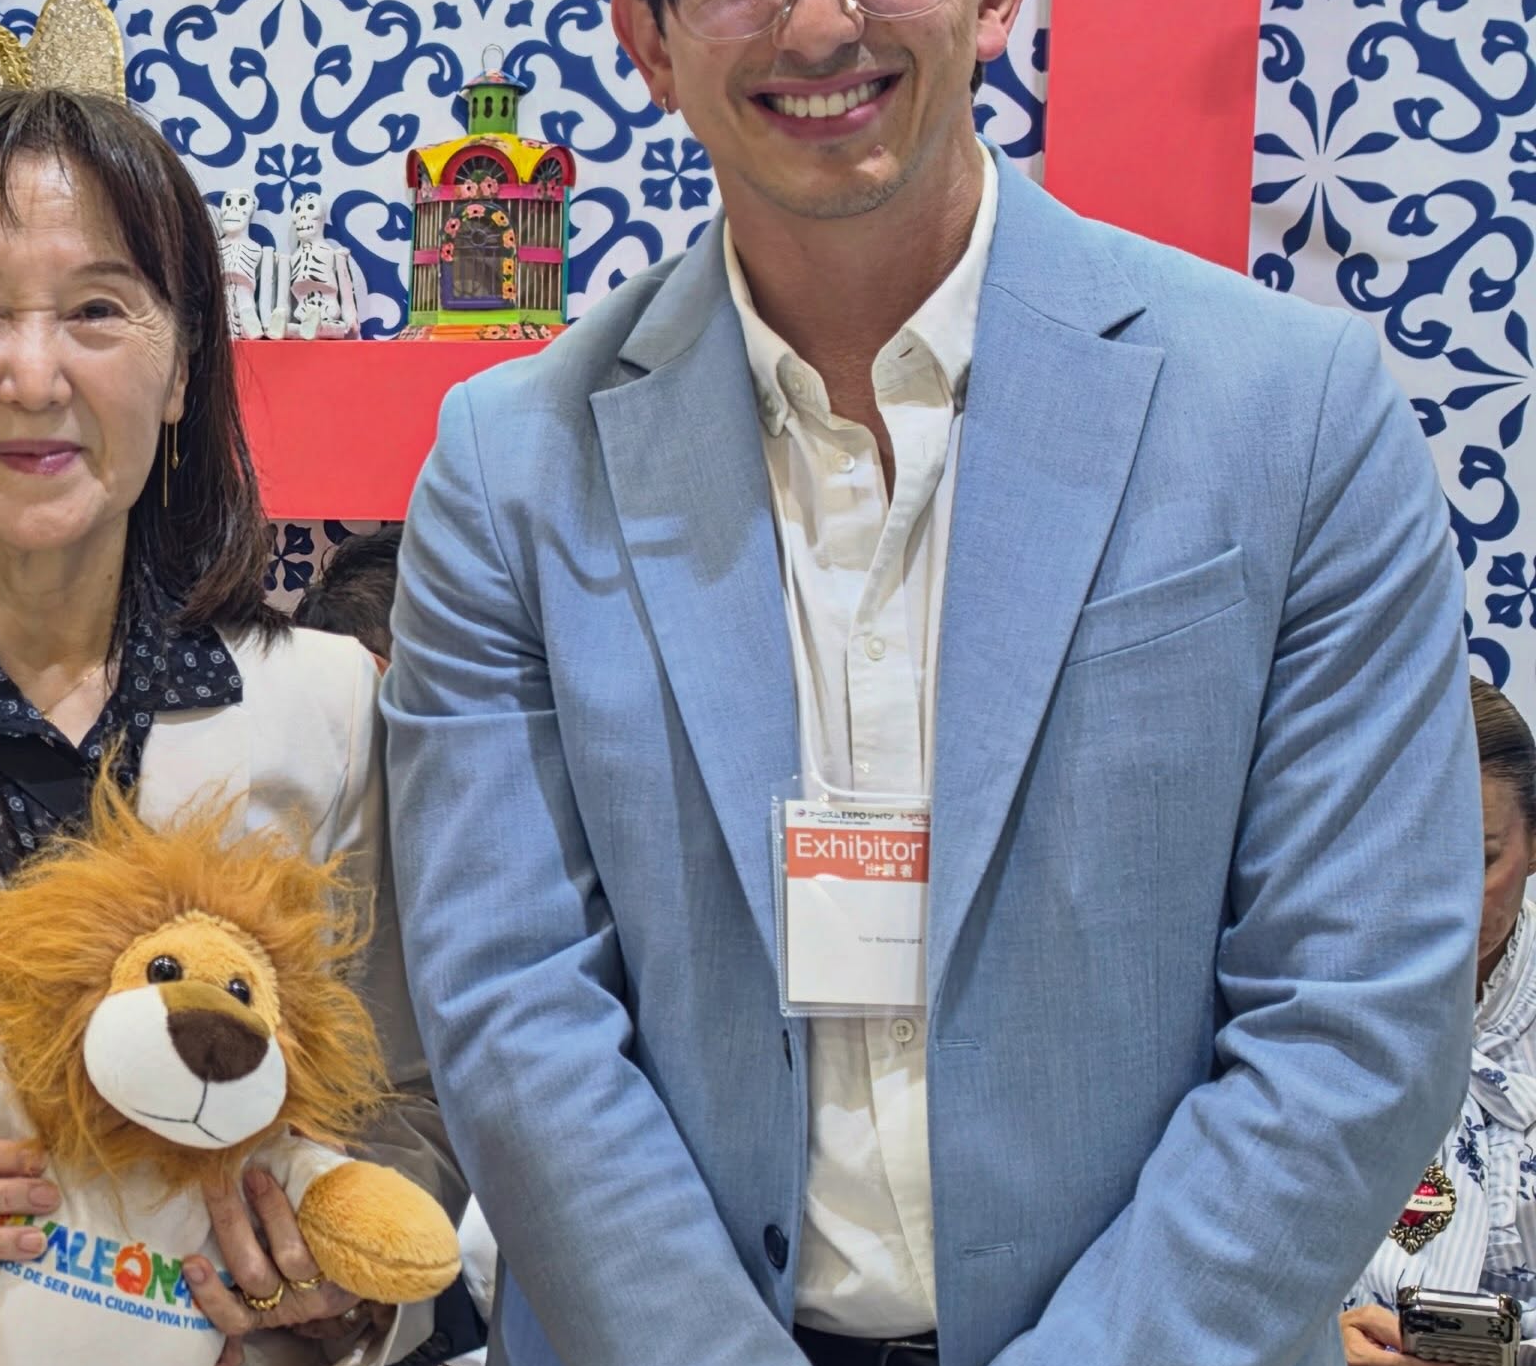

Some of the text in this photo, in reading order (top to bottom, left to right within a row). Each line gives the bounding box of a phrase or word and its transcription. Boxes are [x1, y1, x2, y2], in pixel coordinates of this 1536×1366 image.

[796, 833, 922, 861] Exhibitor
[23, 1267, 42, 1284] DE
[43, 1275, 70, 1296] SER
[71, 1284, 102, 1306] UNA
[104, 1296, 154, 1320] CIUDAD
[156, 1308, 181, 1328] VIVA
[183, 1316, 190, 1329] Y
